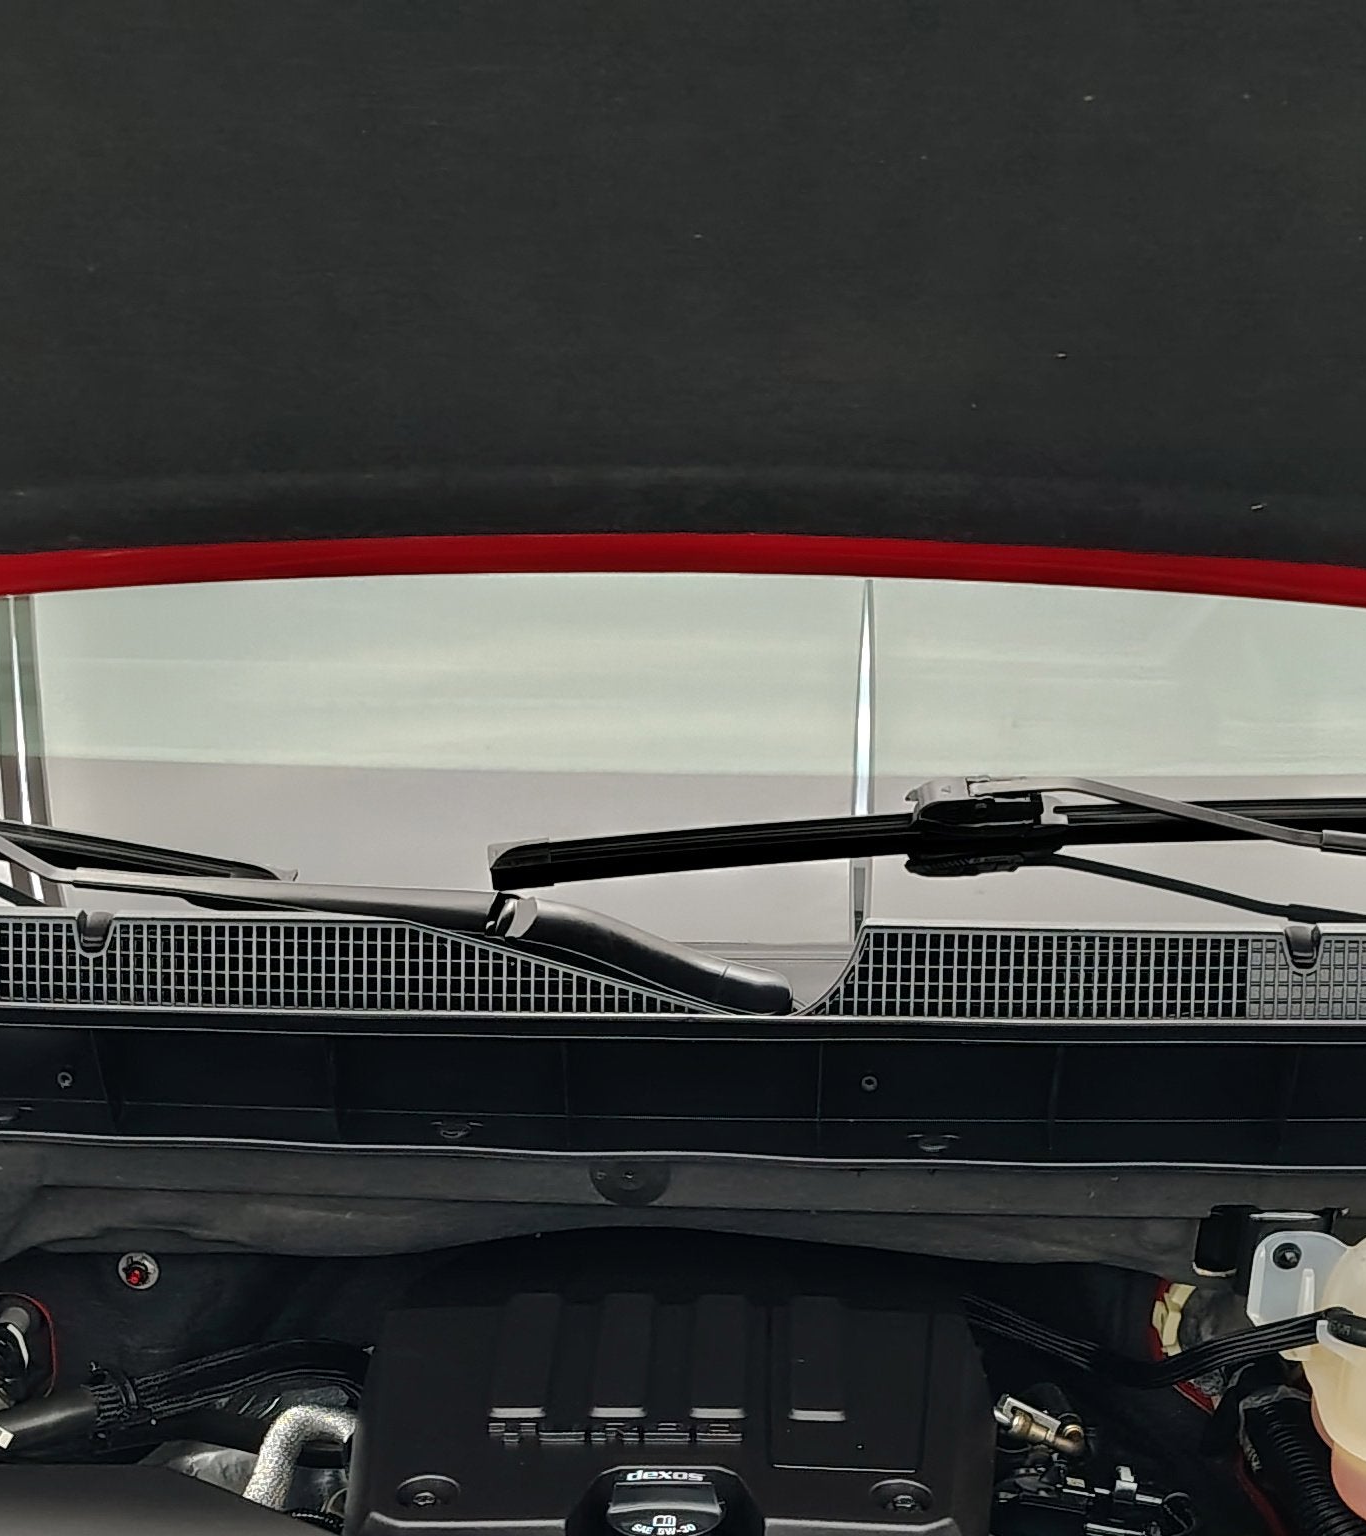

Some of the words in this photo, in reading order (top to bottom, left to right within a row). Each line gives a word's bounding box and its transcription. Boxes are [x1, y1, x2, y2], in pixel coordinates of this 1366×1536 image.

[626, 1470, 706, 1481] dexos
[632, 1524, 654, 1535] SAE
[657, 1523, 697, 1535] 5W-30
